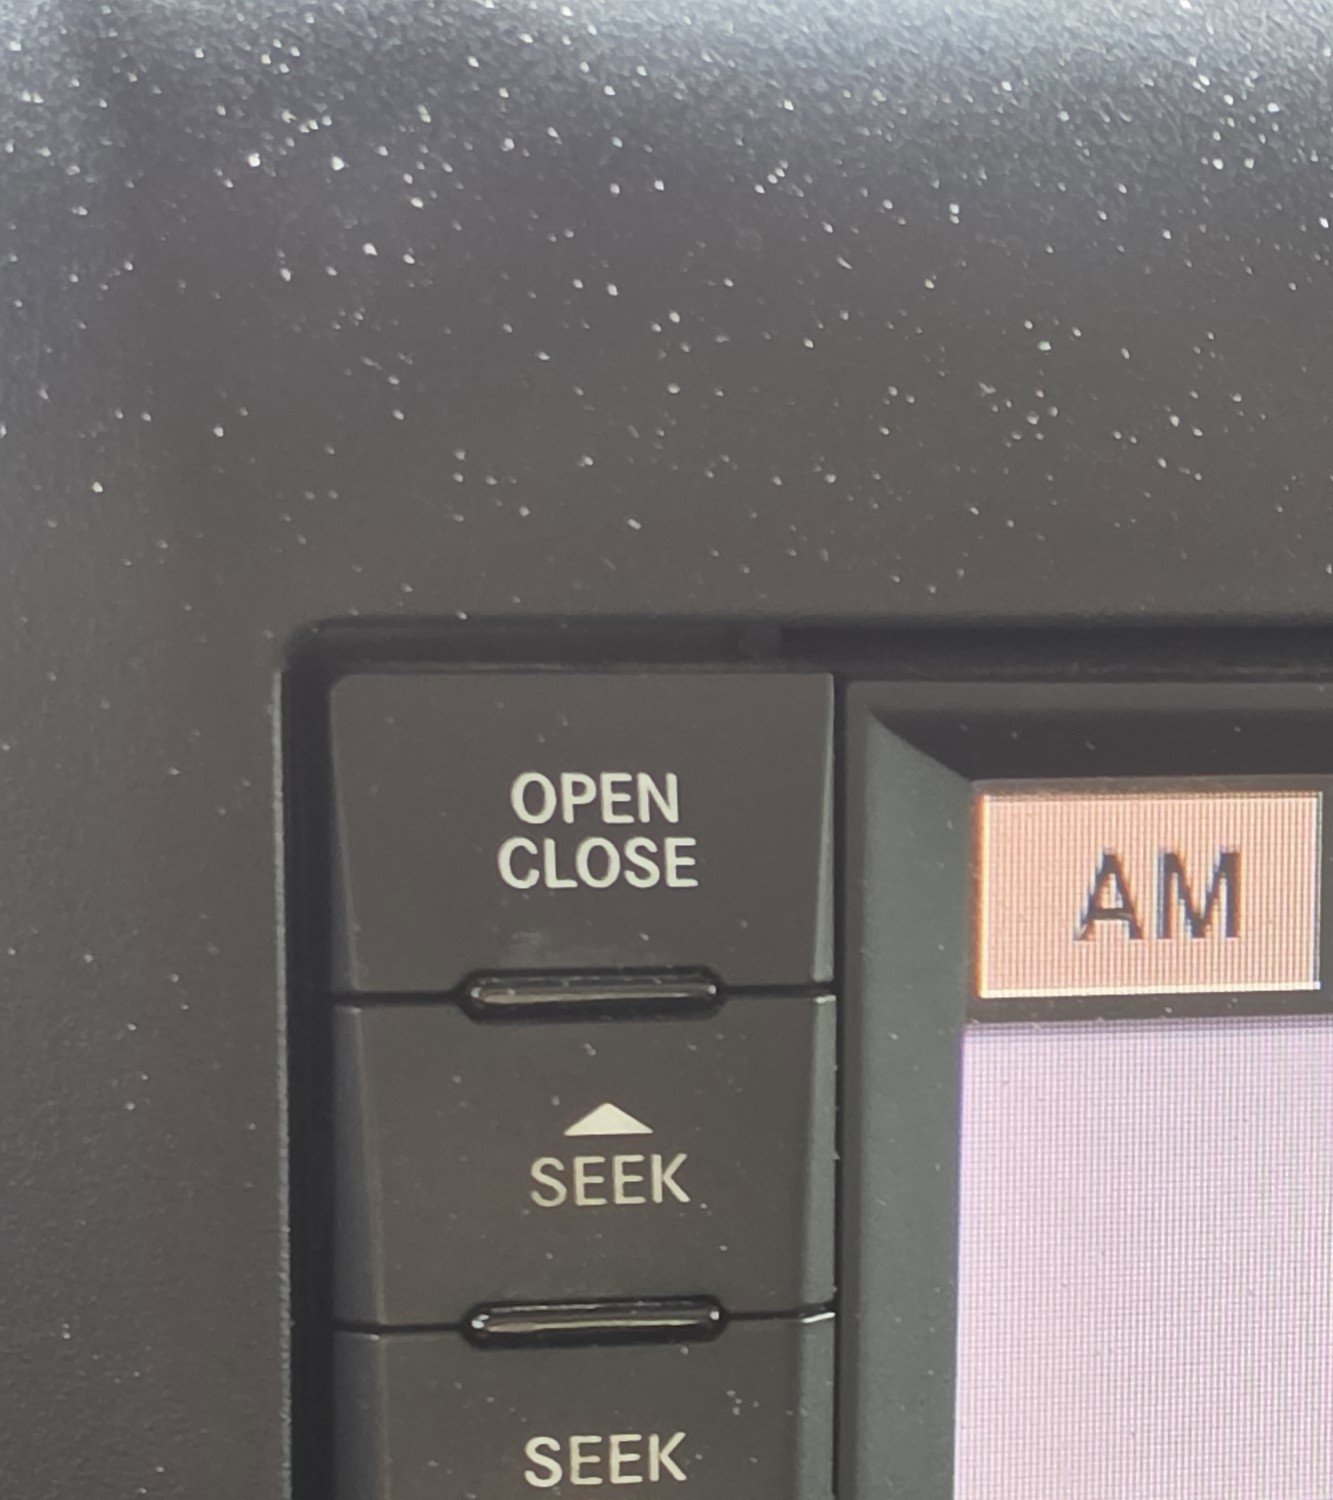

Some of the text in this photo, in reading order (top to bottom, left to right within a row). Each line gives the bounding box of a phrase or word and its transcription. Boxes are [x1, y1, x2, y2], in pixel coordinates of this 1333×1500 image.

[509, 770, 681, 825] OPEN
[498, 836, 700, 890] CLOSE
[1075, 846, 1242, 942] AM
[529, 1152, 692, 1208] SEEK
[523, 1430, 688, 1488] SEEK
